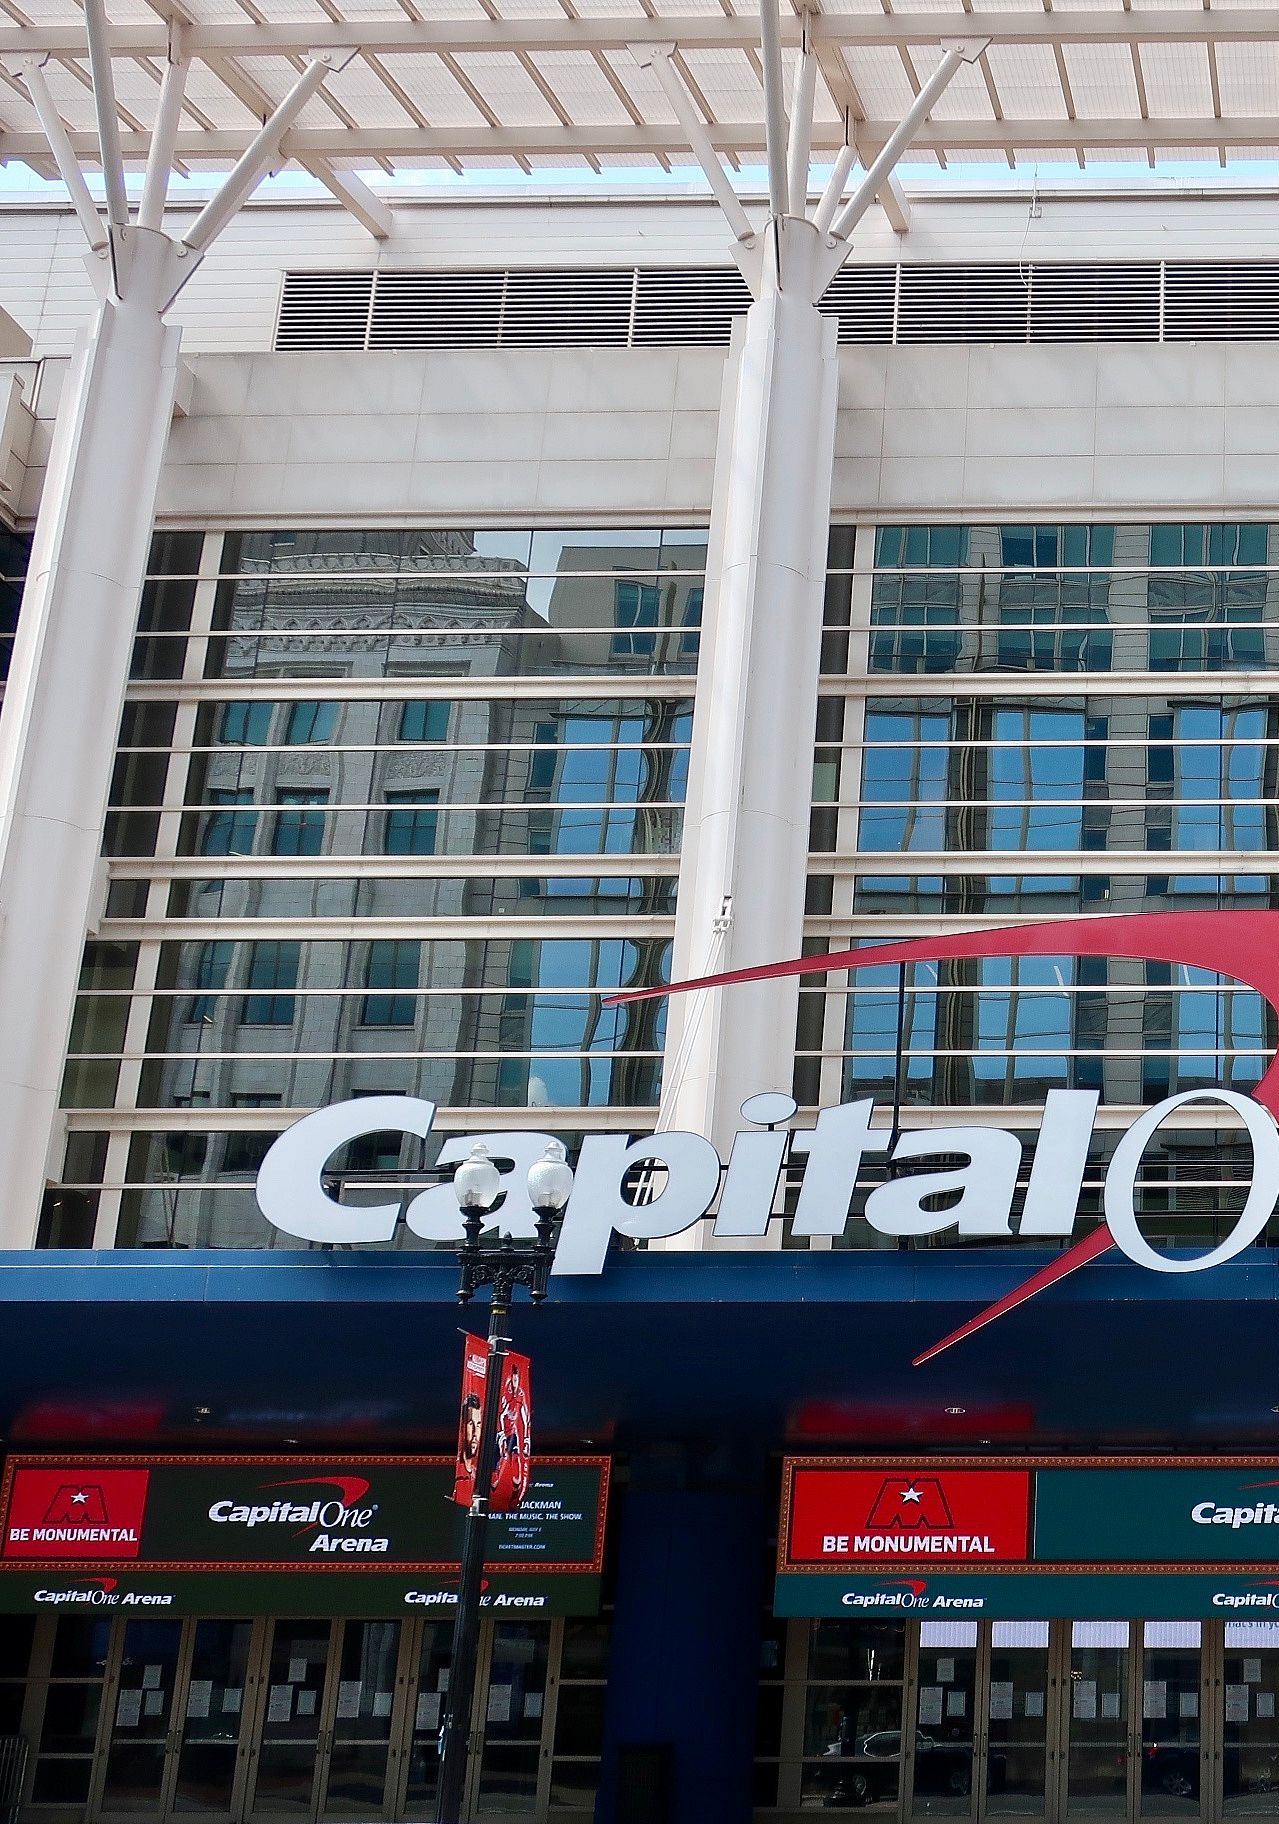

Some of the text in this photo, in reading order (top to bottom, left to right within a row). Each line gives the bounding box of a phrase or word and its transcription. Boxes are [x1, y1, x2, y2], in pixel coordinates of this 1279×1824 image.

[10, 1528, 138, 1541] BE MONUMENTAL
[309, 1535, 391, 1552] Arena
[823, 1536, 995, 1552] BE MONUMENTAL
[121, 1592, 173, 1605] Arena
[493, 1594, 545, 1607] Arena
[932, 1595, 984, 1608] Arena
